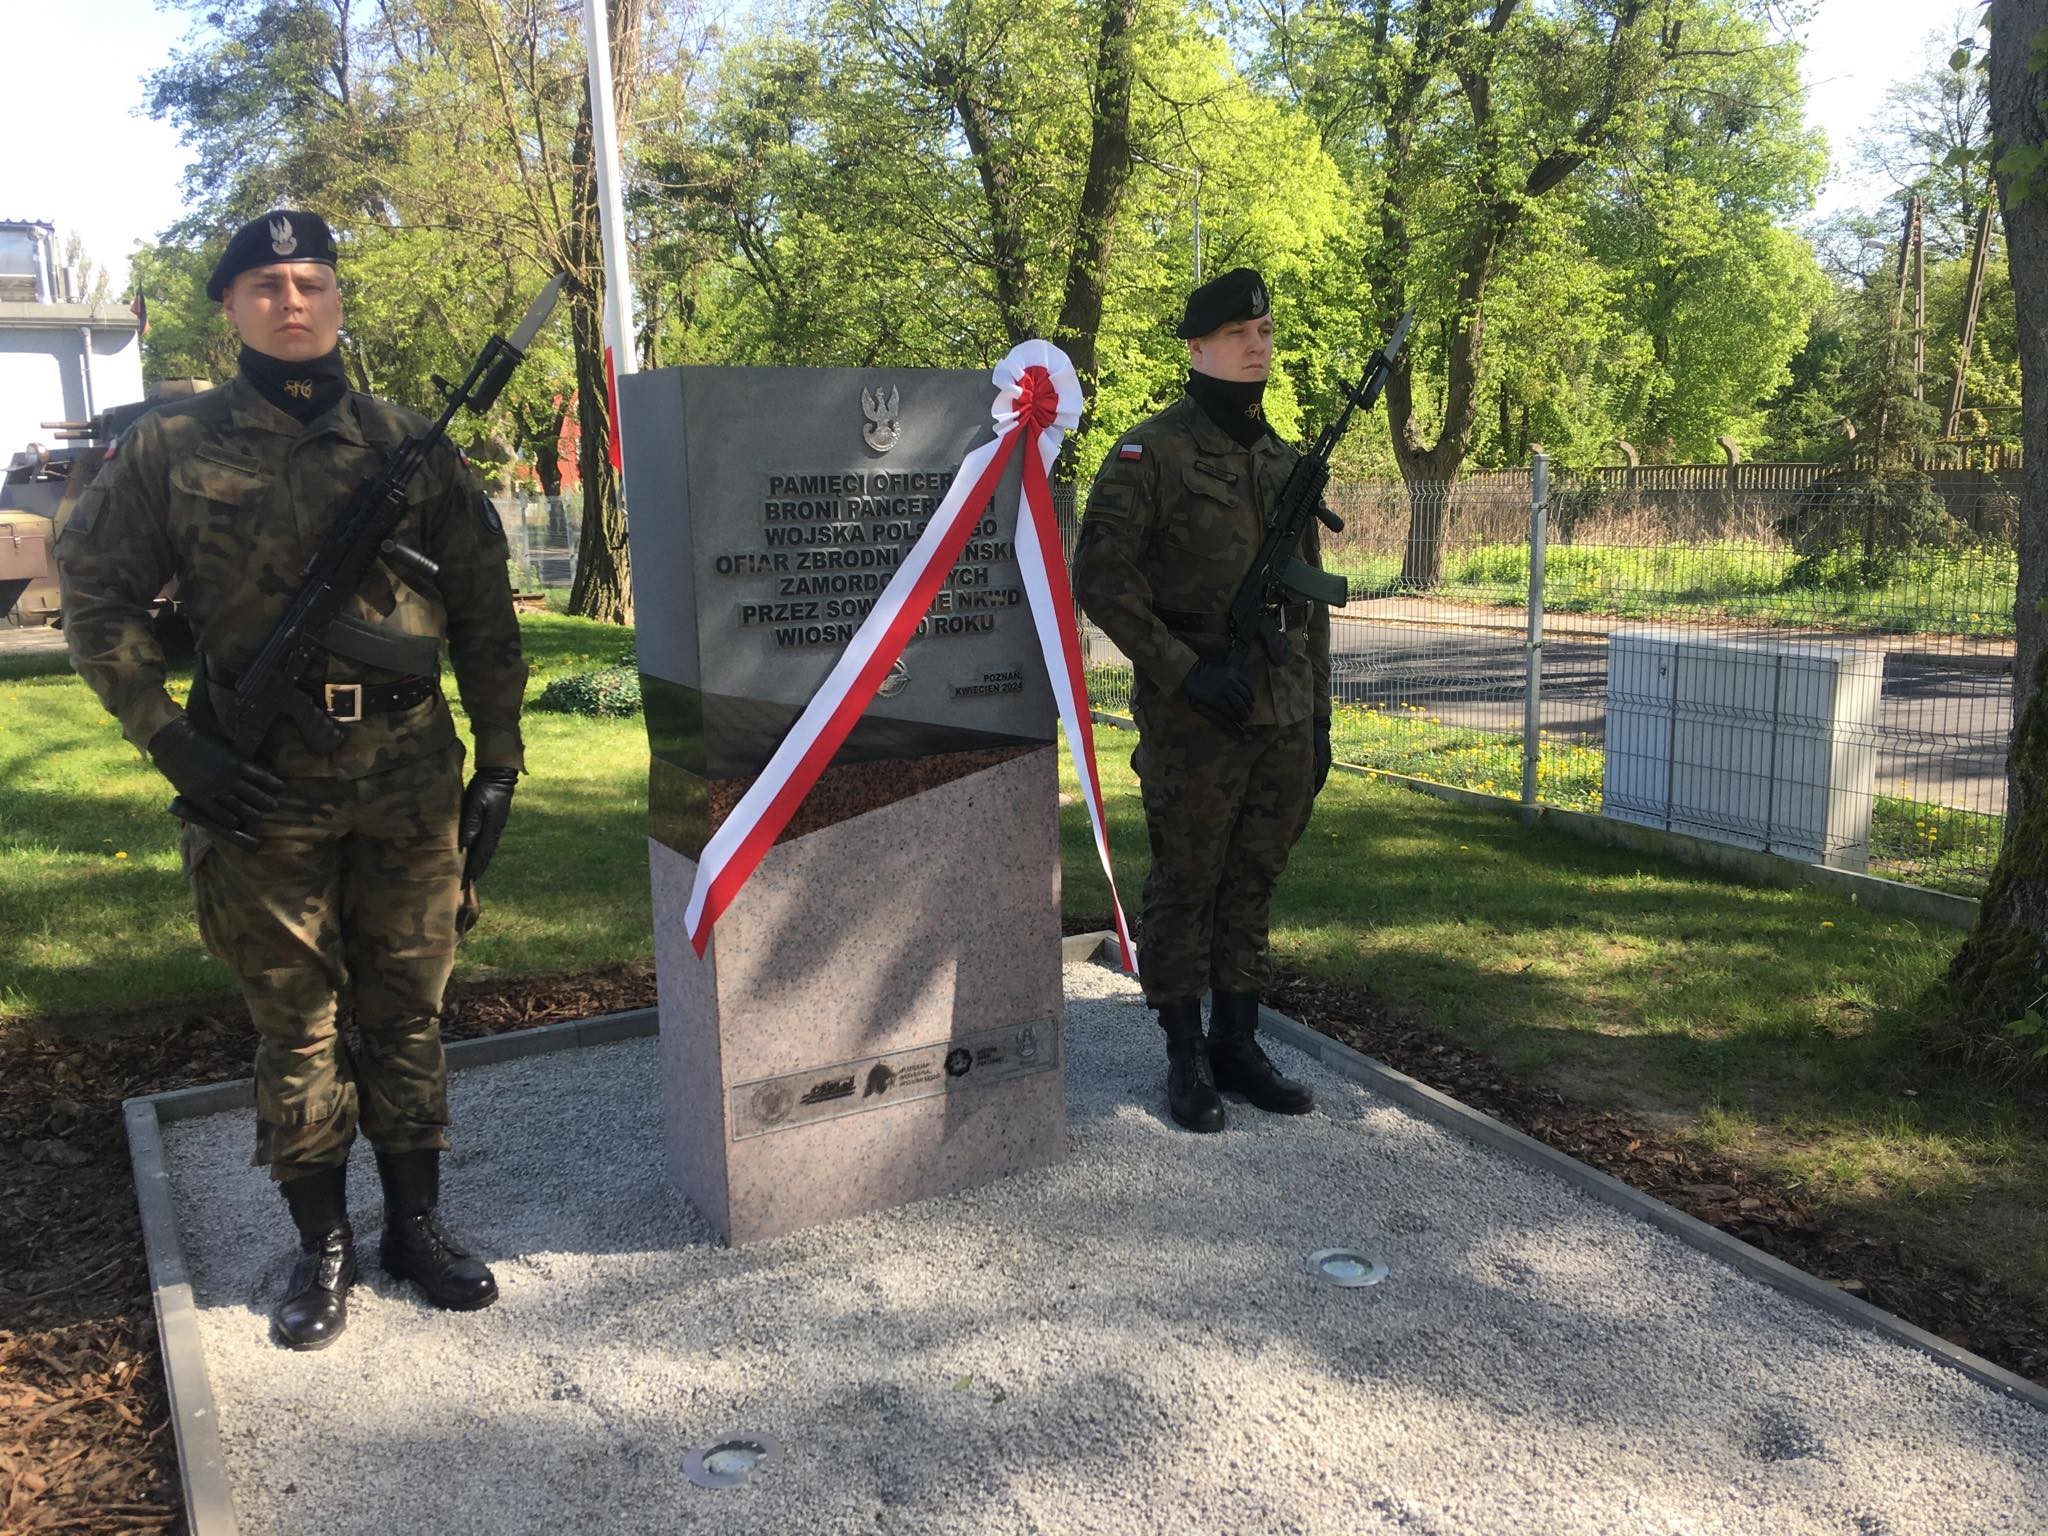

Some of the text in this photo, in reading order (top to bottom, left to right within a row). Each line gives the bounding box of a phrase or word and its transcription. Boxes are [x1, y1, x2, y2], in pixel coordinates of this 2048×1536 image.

[770, 472, 955, 497] PAMIĘCI OFICER
[765, 500, 839, 521] BRONI
[765, 523, 865, 546] WOJSKA
[716, 553, 789, 574] OFIAR
[797, 547, 899, 571] ZBRODNI
[743, 602, 819, 624] PRZEZ
[958, 589, 1020, 608] NKWD
[776, 624, 864, 646] WIOSN
[935, 614, 993, 634] ROKU
[955, 681, 1000, 697] KWIECIEŃ
